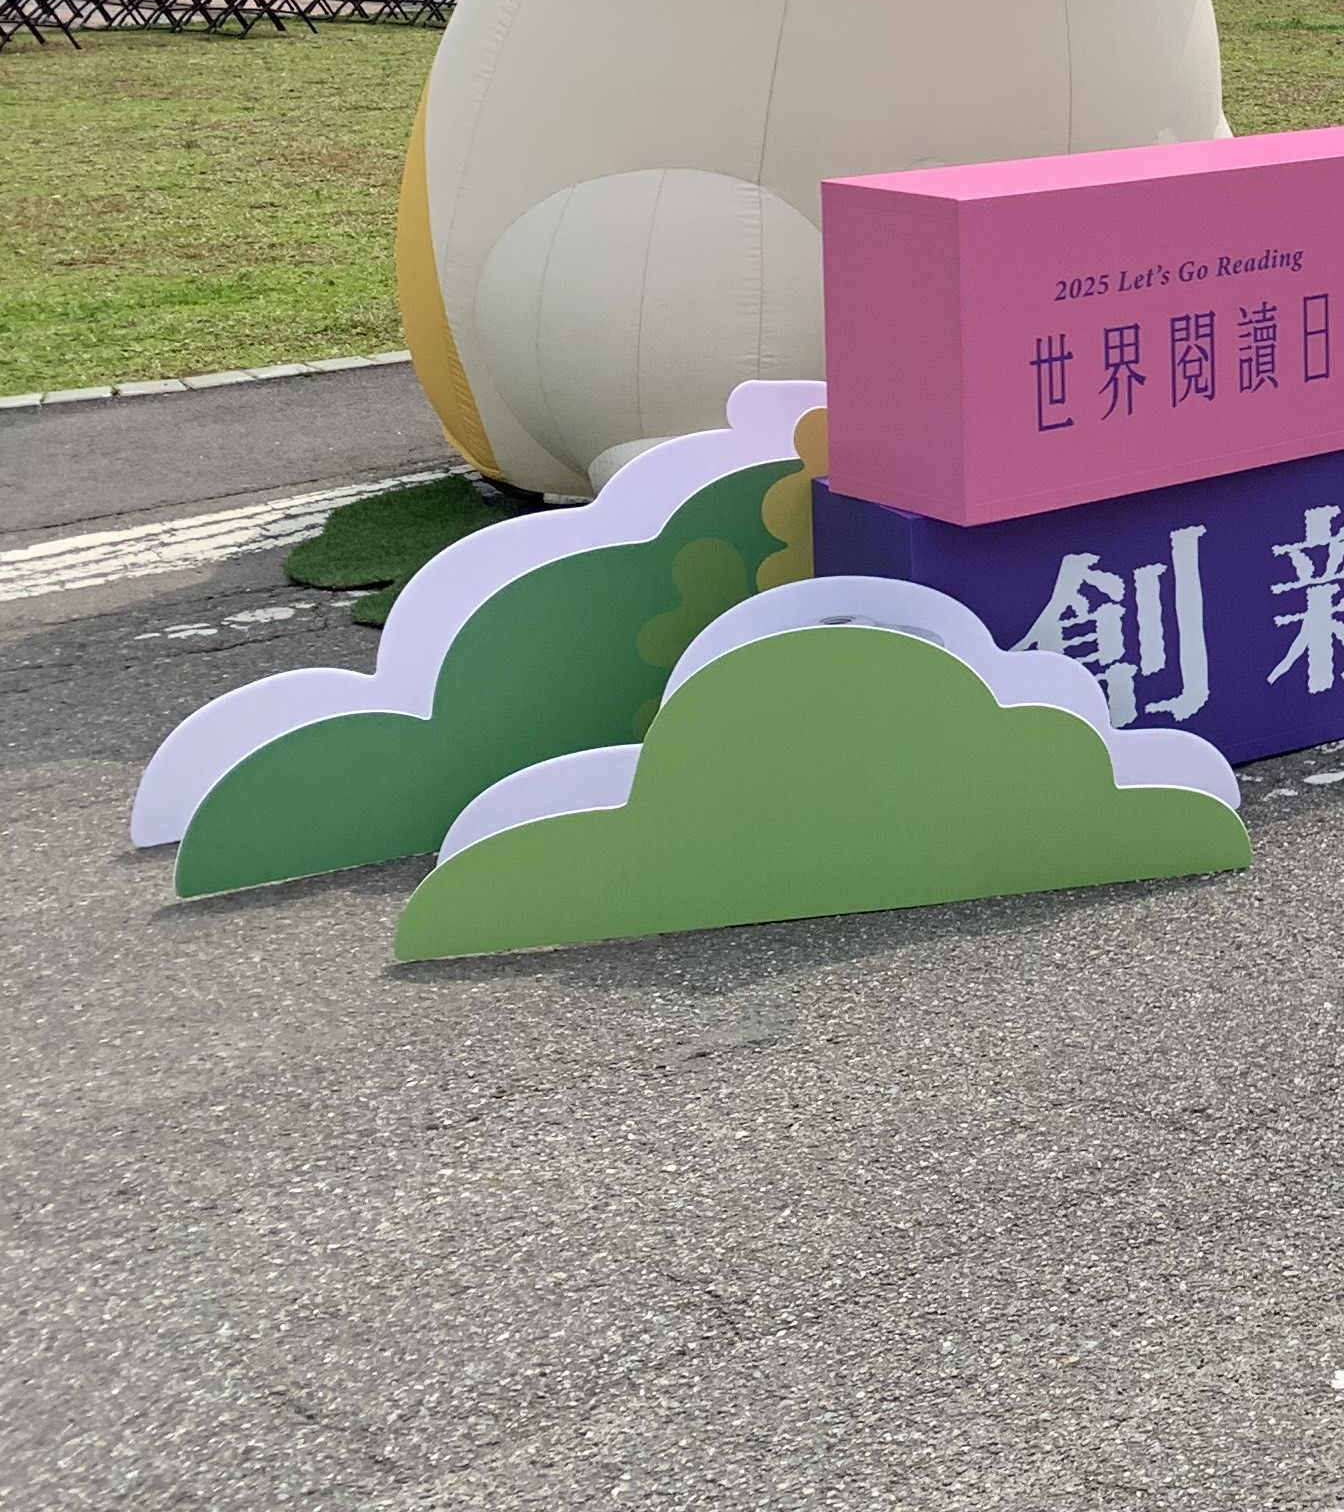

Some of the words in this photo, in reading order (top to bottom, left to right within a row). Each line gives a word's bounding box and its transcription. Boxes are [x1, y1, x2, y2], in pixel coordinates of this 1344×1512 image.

[1053, 273, 1110, 302] 2025
[1118, 264, 1170, 292] Let’s
[1178, 261, 1208, 283] Go
[1215, 249, 1304, 277] Reading
[1029, 292, 1330, 432] 世界閱讀日
